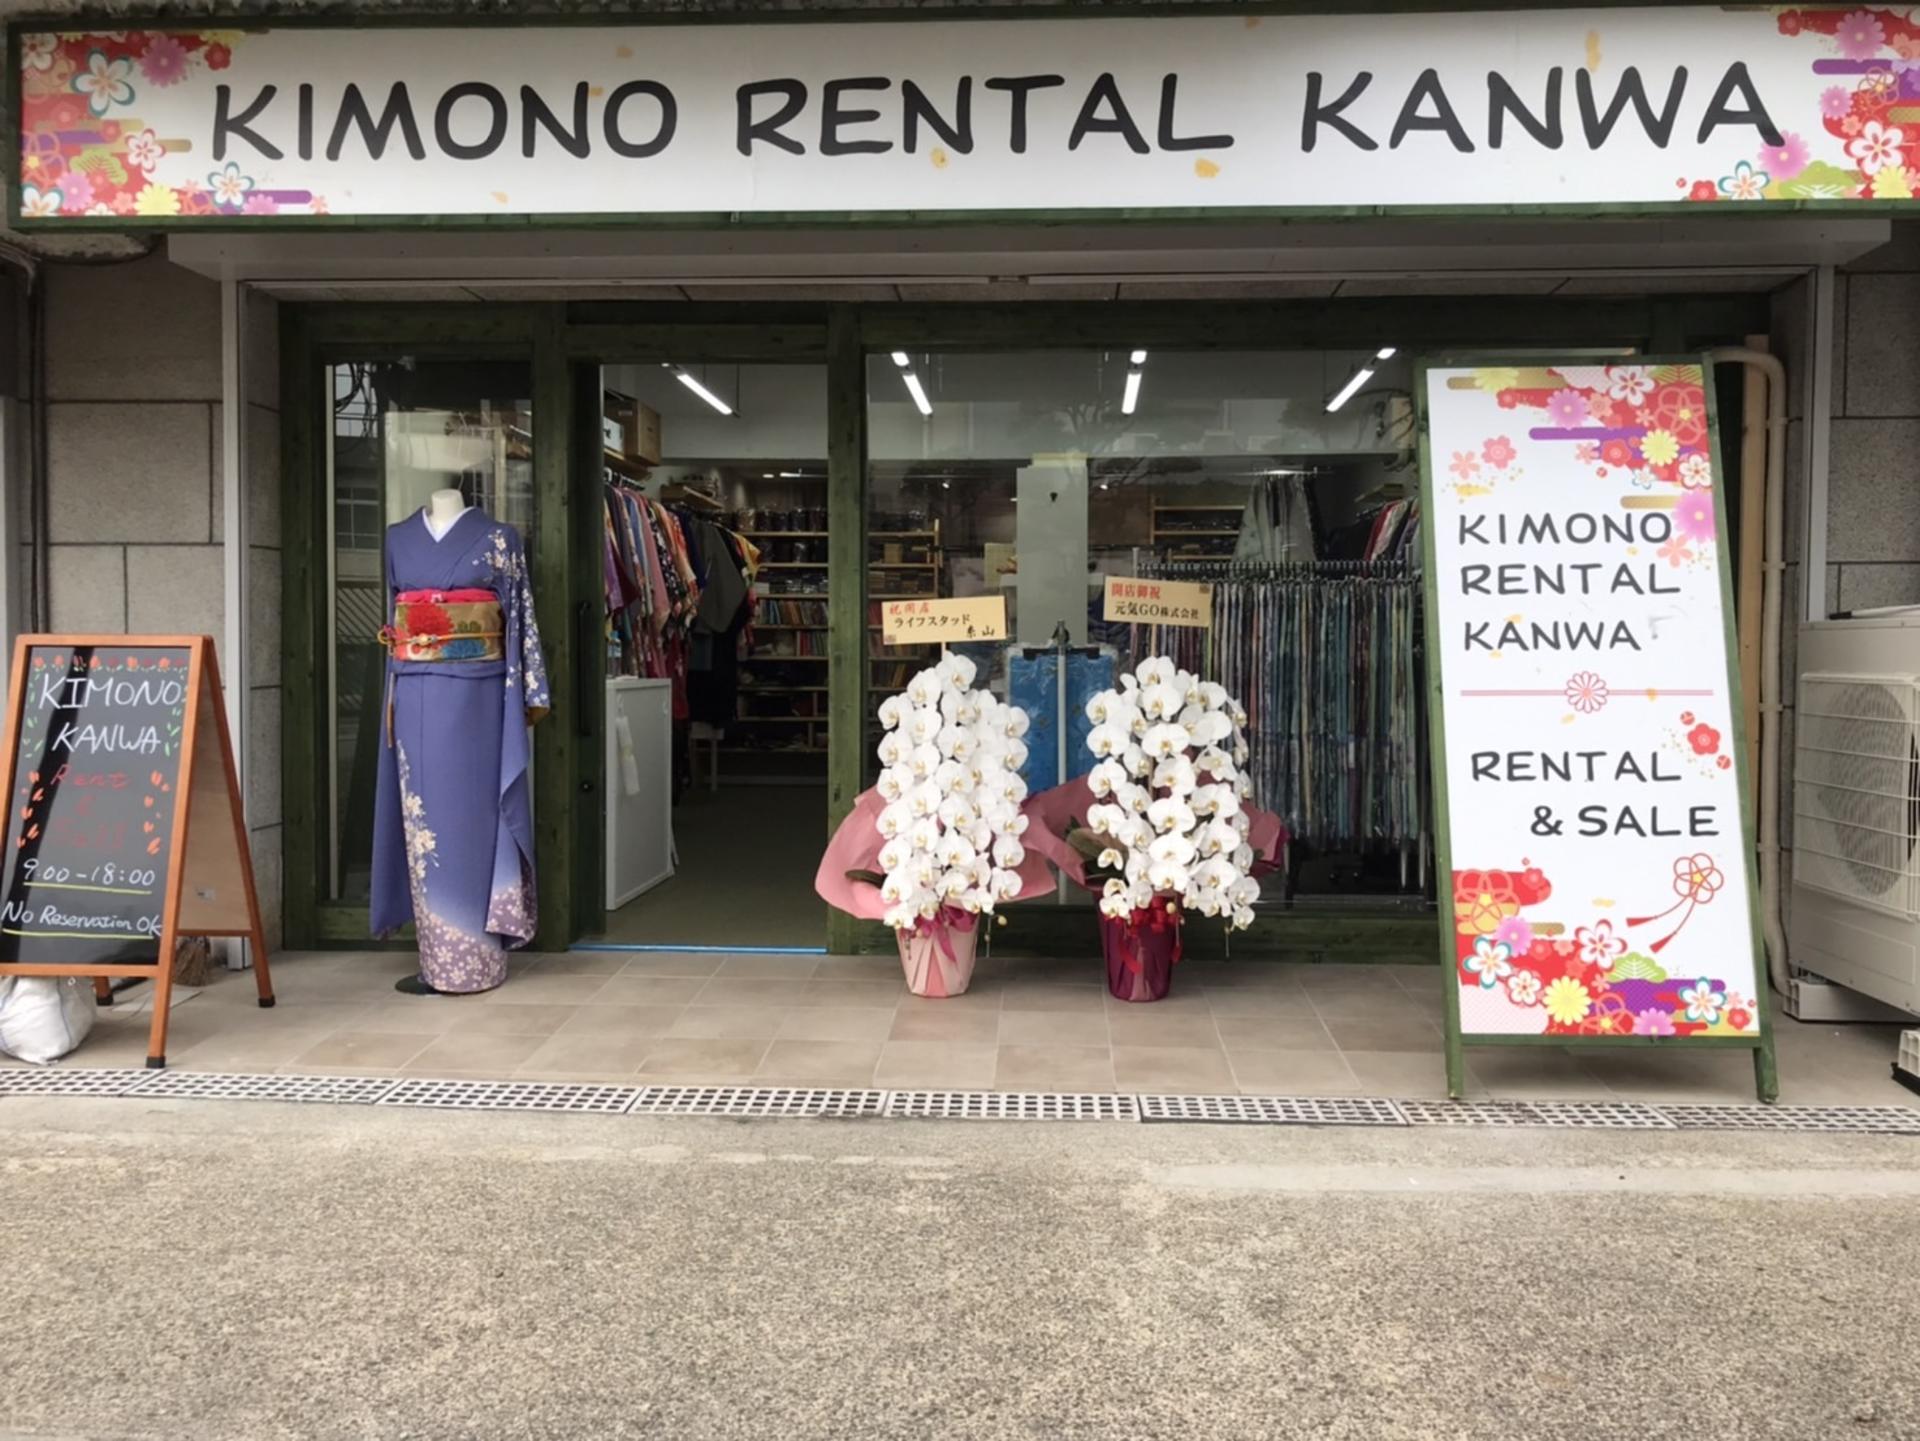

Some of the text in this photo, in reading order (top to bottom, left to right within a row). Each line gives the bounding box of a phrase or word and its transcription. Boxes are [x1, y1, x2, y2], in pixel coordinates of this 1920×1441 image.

[213, 61, 1786, 161] KIMONO RENTAL KANWA
[1459, 513, 1671, 544] KIMONO
[1461, 563, 1680, 595] RENTAL
[1115, 601, 1199, 619] 元気GO株式会社
[1465, 621, 1641, 651] KANWA
[38, 673, 182, 709] KIMONO
[51, 722, 161, 754] KANWA
[1471, 751, 1681, 782] RENTAL
[1531, 805, 1719, 837] & SALE
[1, 901, 34, 922] No
